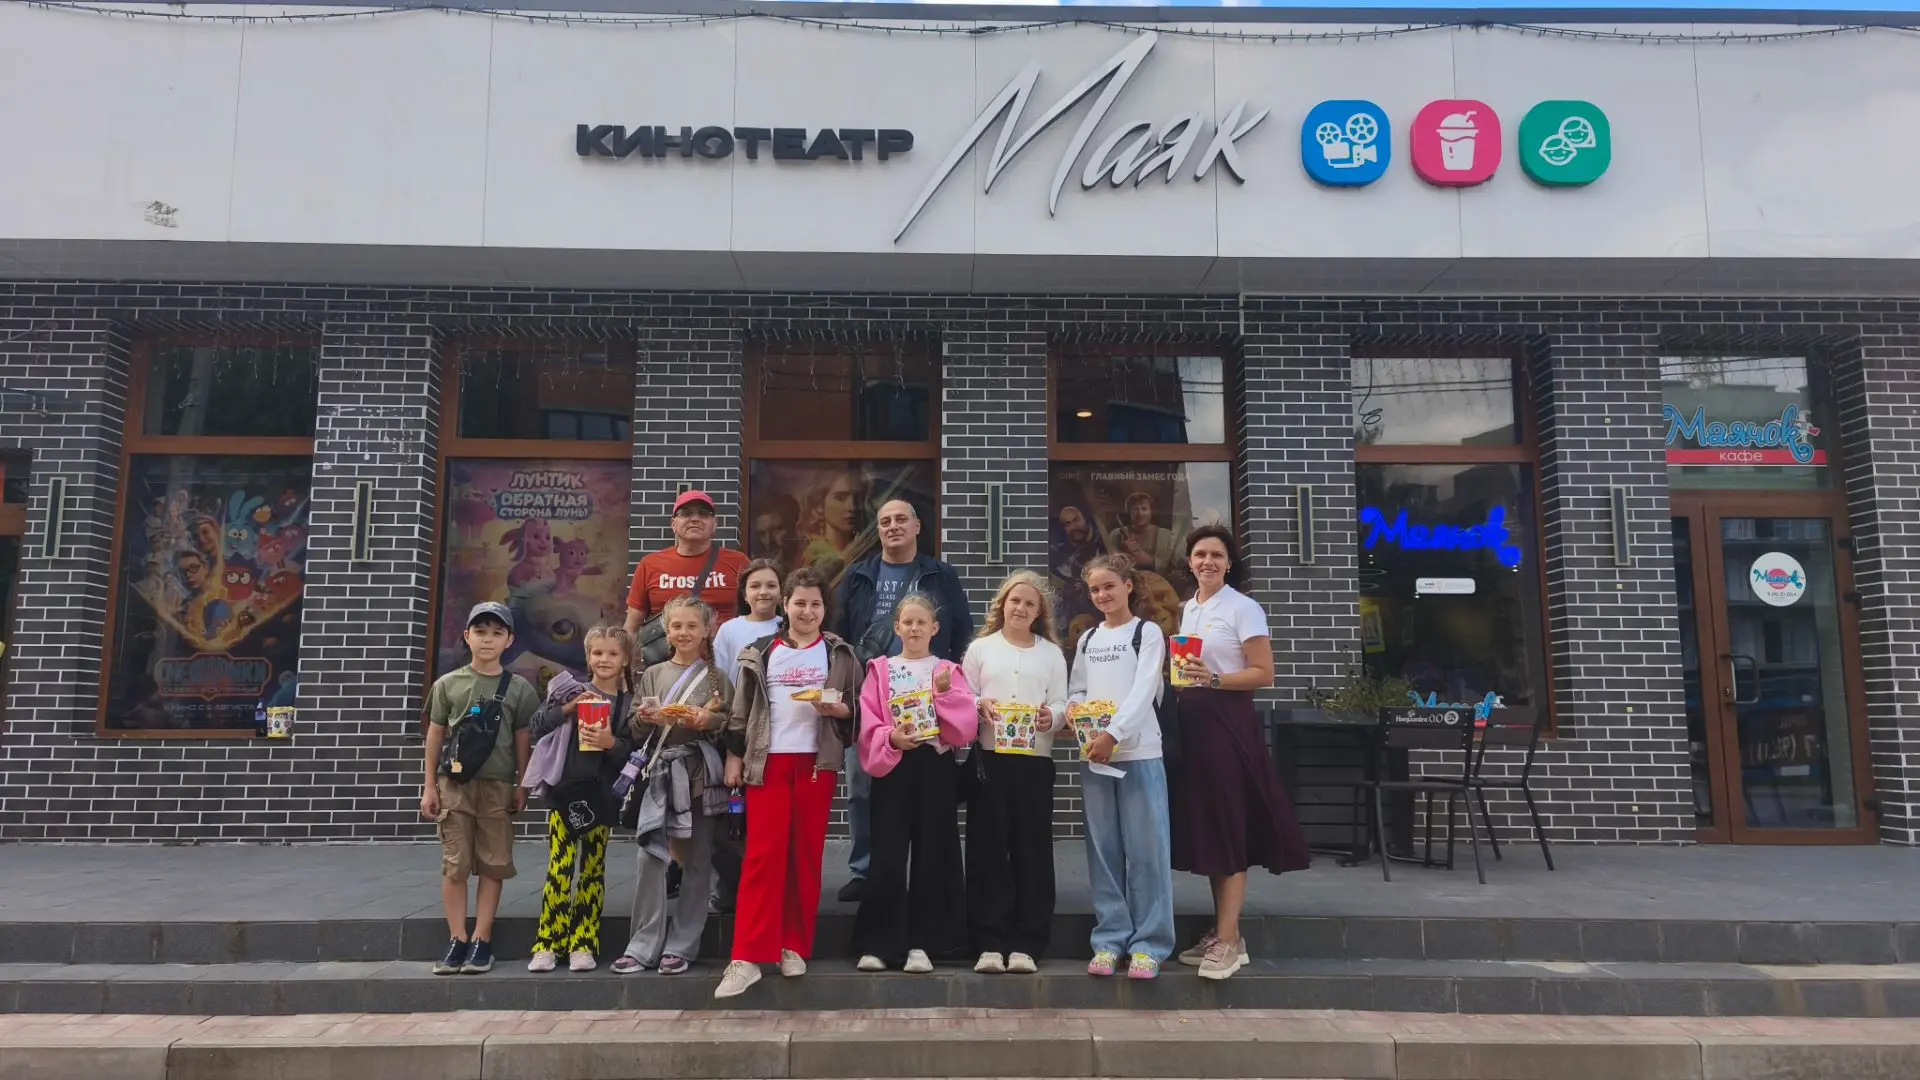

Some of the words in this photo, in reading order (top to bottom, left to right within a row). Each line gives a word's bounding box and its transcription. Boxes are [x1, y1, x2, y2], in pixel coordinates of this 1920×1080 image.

[577, 124, 913, 162] КИНОТЕАТР
[894, 31, 1272, 244] Маяк
[1662, 403, 1815, 463] Маячок
[1719, 450, 1764, 464] кафе
[509, 471, 584, 489] ЛУНТИК
[1090, 471, 1134, 481] ГЛАВНЫЙ
[1136, 472, 1165, 481] ЗАМЕС
[500, 493, 587, 507] ОБРАТНАЯ
[500, 507, 552, 518] СТОРОНА
[555, 507, 588, 519] ЛУНЫ
